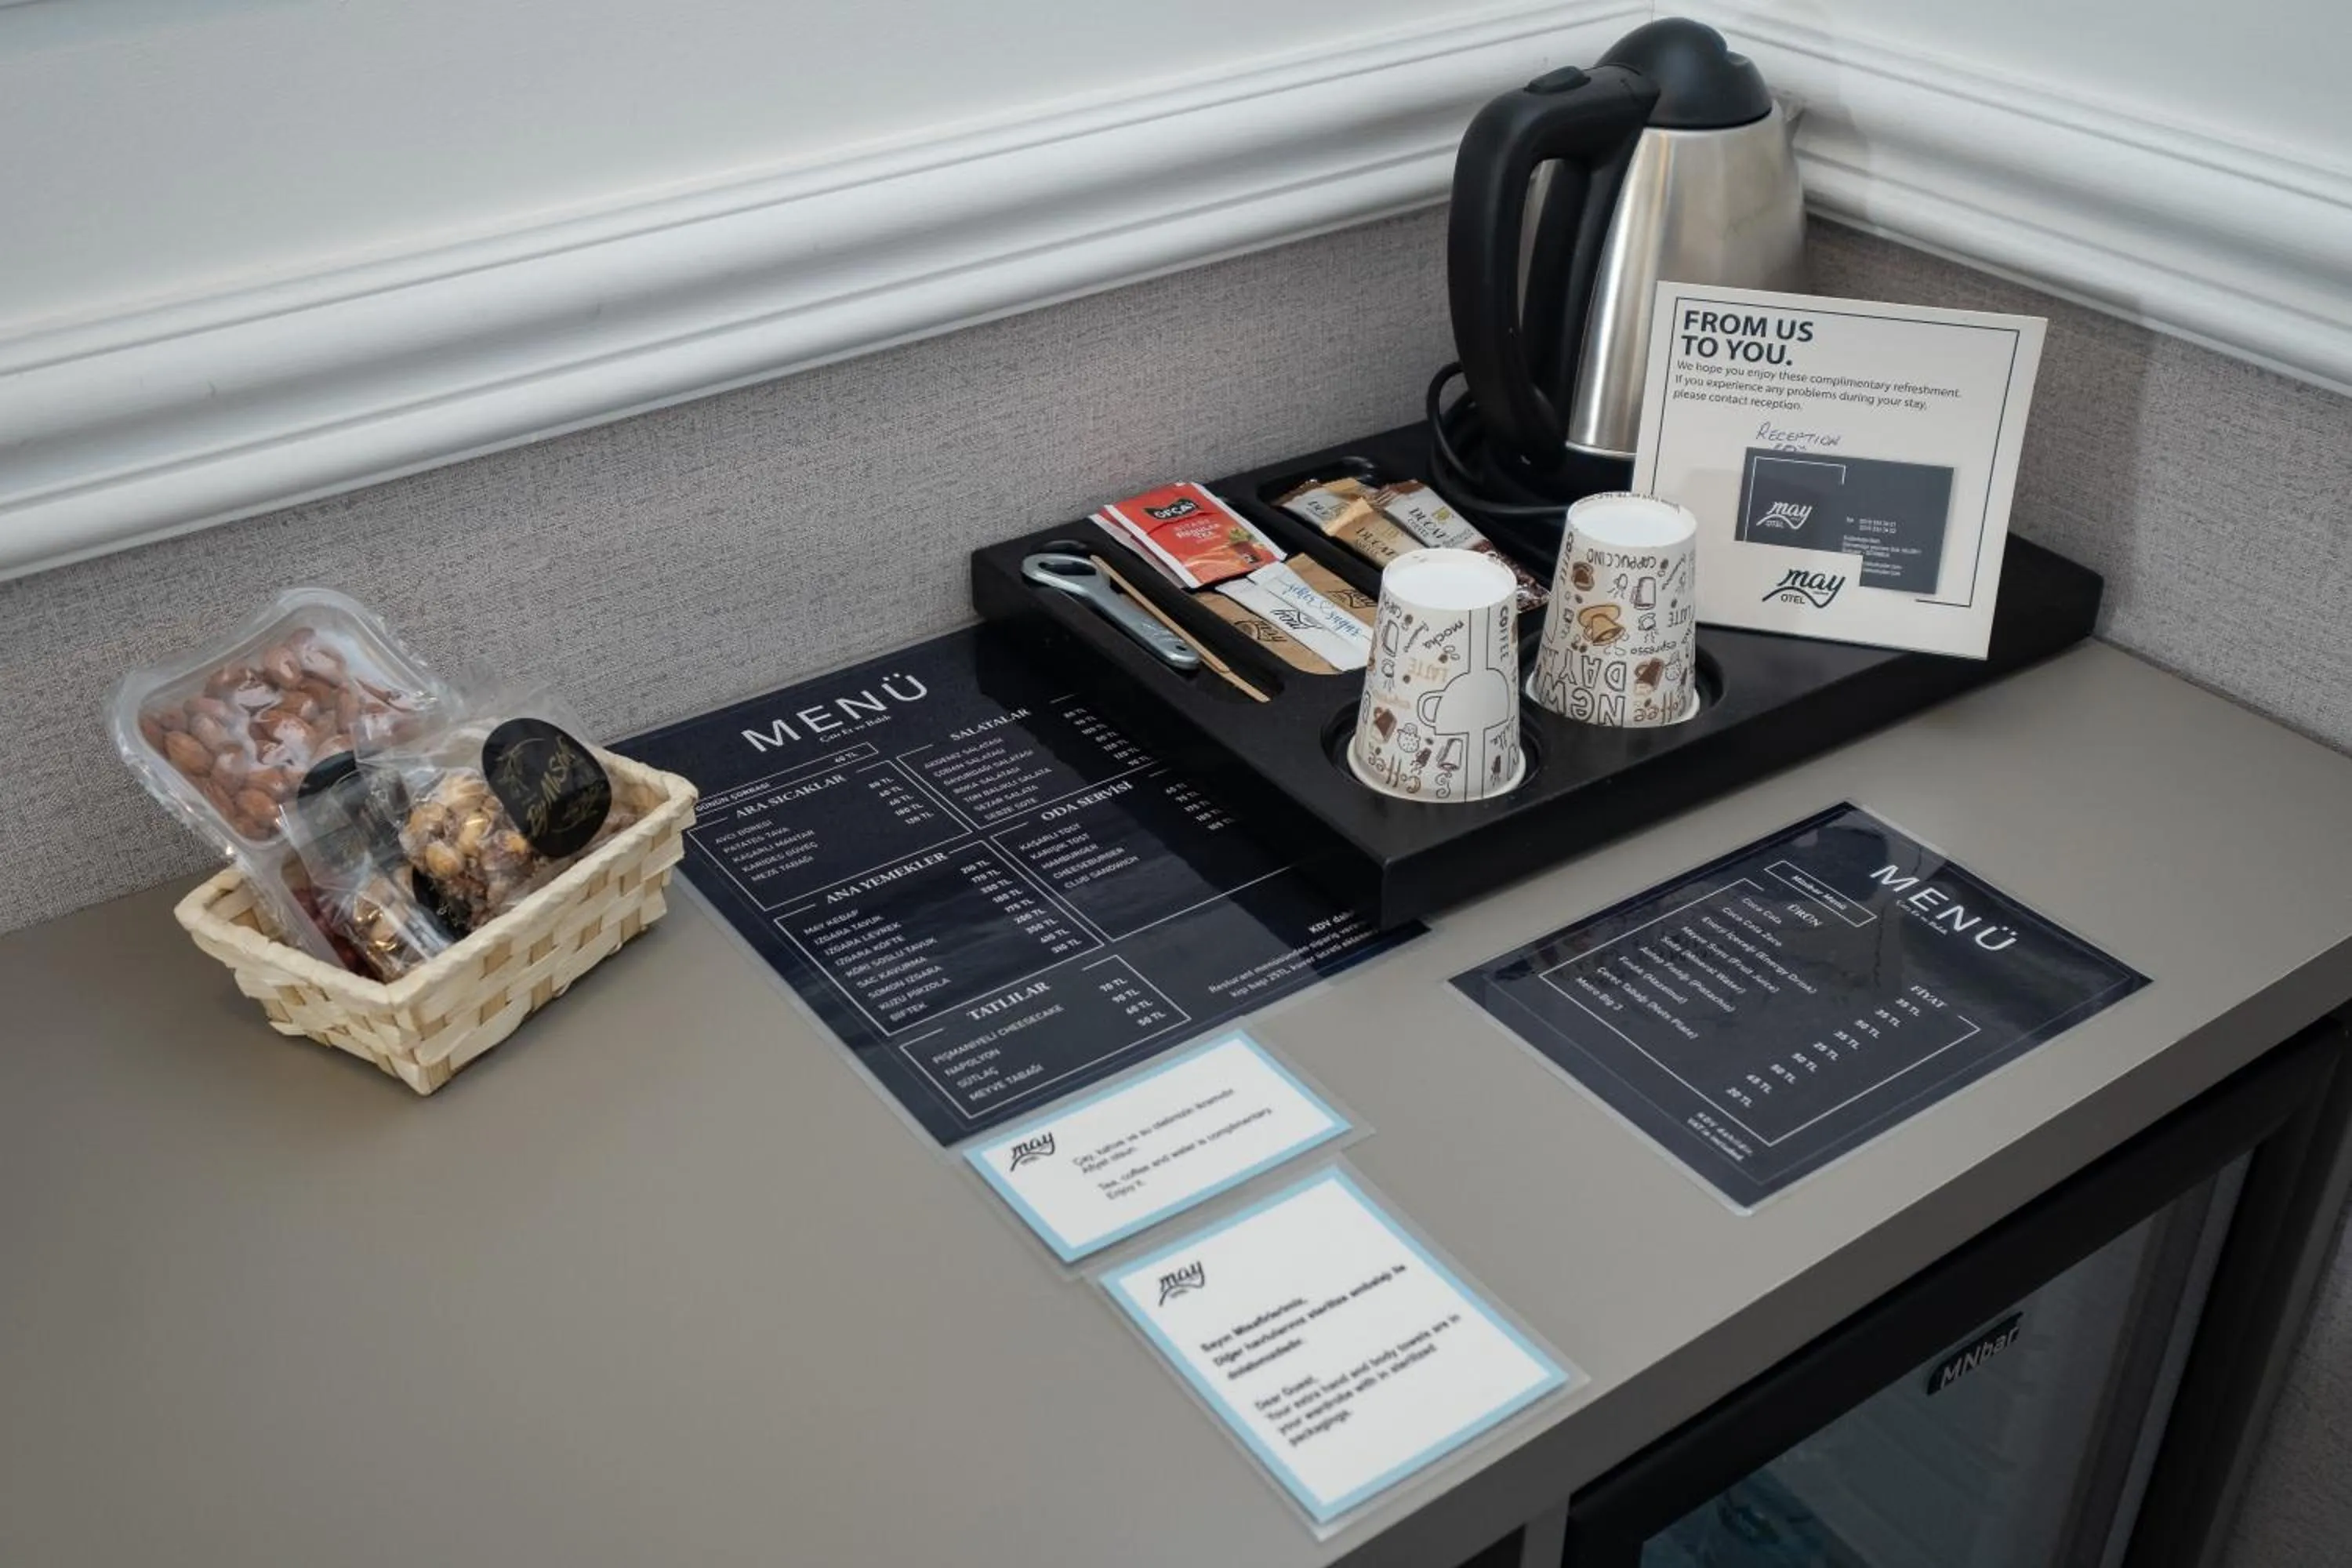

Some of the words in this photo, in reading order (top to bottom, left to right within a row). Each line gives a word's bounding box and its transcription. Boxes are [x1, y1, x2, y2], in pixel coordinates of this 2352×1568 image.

[1683, 310, 1768, 337] FROM
[1777, 318, 1814, 343] US
[1681, 335, 1719, 358] TO
[1726, 339, 1793, 366] YOU.
[1675, 374, 1683, 383] If
[1685, 377, 1704, 387] you
[1706, 378, 1763, 393] experience
[1765, 385, 1784, 396] any
[1787, 386, 1836, 400] problems
[1838, 390, 1875, 405] during
[1878, 396, 1901, 407] your
[1677, 360, 1694, 371] We
[1696, 362, 1722, 374] hope
[1725, 366, 1744, 377] you
[1747, 368, 1776, 380] enjoy
[1779, 370, 1808, 382] these
[1809, 374, 1892, 392] complimentary
[1893, 382, 1961, 397] refreshment.
[1672, 389, 1707, 400] please
[1708, 394, 1748, 405] contact
[1751, 398, 1802, 411] reception.
[1756, 422, 1841, 446] RECEPTION
[1409, 507, 1448, 539] DUCAT
[1763, 501, 1813, 523] may
[1356, 527, 1396, 557] DUCAT
[1586, 549, 1657, 569] CAPPUCCINO
[1775, 569, 1846, 599] may
[1780, 593, 1806, 604] OTEL
[1630, 641, 1678, 656] espresso
[741, 673, 927, 752] MENÜ
[950, 709, 1029, 741] SALATALAR
[1368, 747, 1421, 794] Coffee
[736, 802, 768, 818] ARA
[768, 775, 846, 804] SICAKLAR
[1040, 804, 1079, 820] ODA
[1076, 780, 1132, 807] SERVİSİ
[827, 886, 862, 904] ANA
[859, 852, 947, 889] YEMEKLER
[1870, 864, 2017, 950] MENÜ
[966, 982, 1050, 1019] TATLILAR
[1011, 1132, 1054, 1165] may
[1159, 1261, 1204, 1299] may
